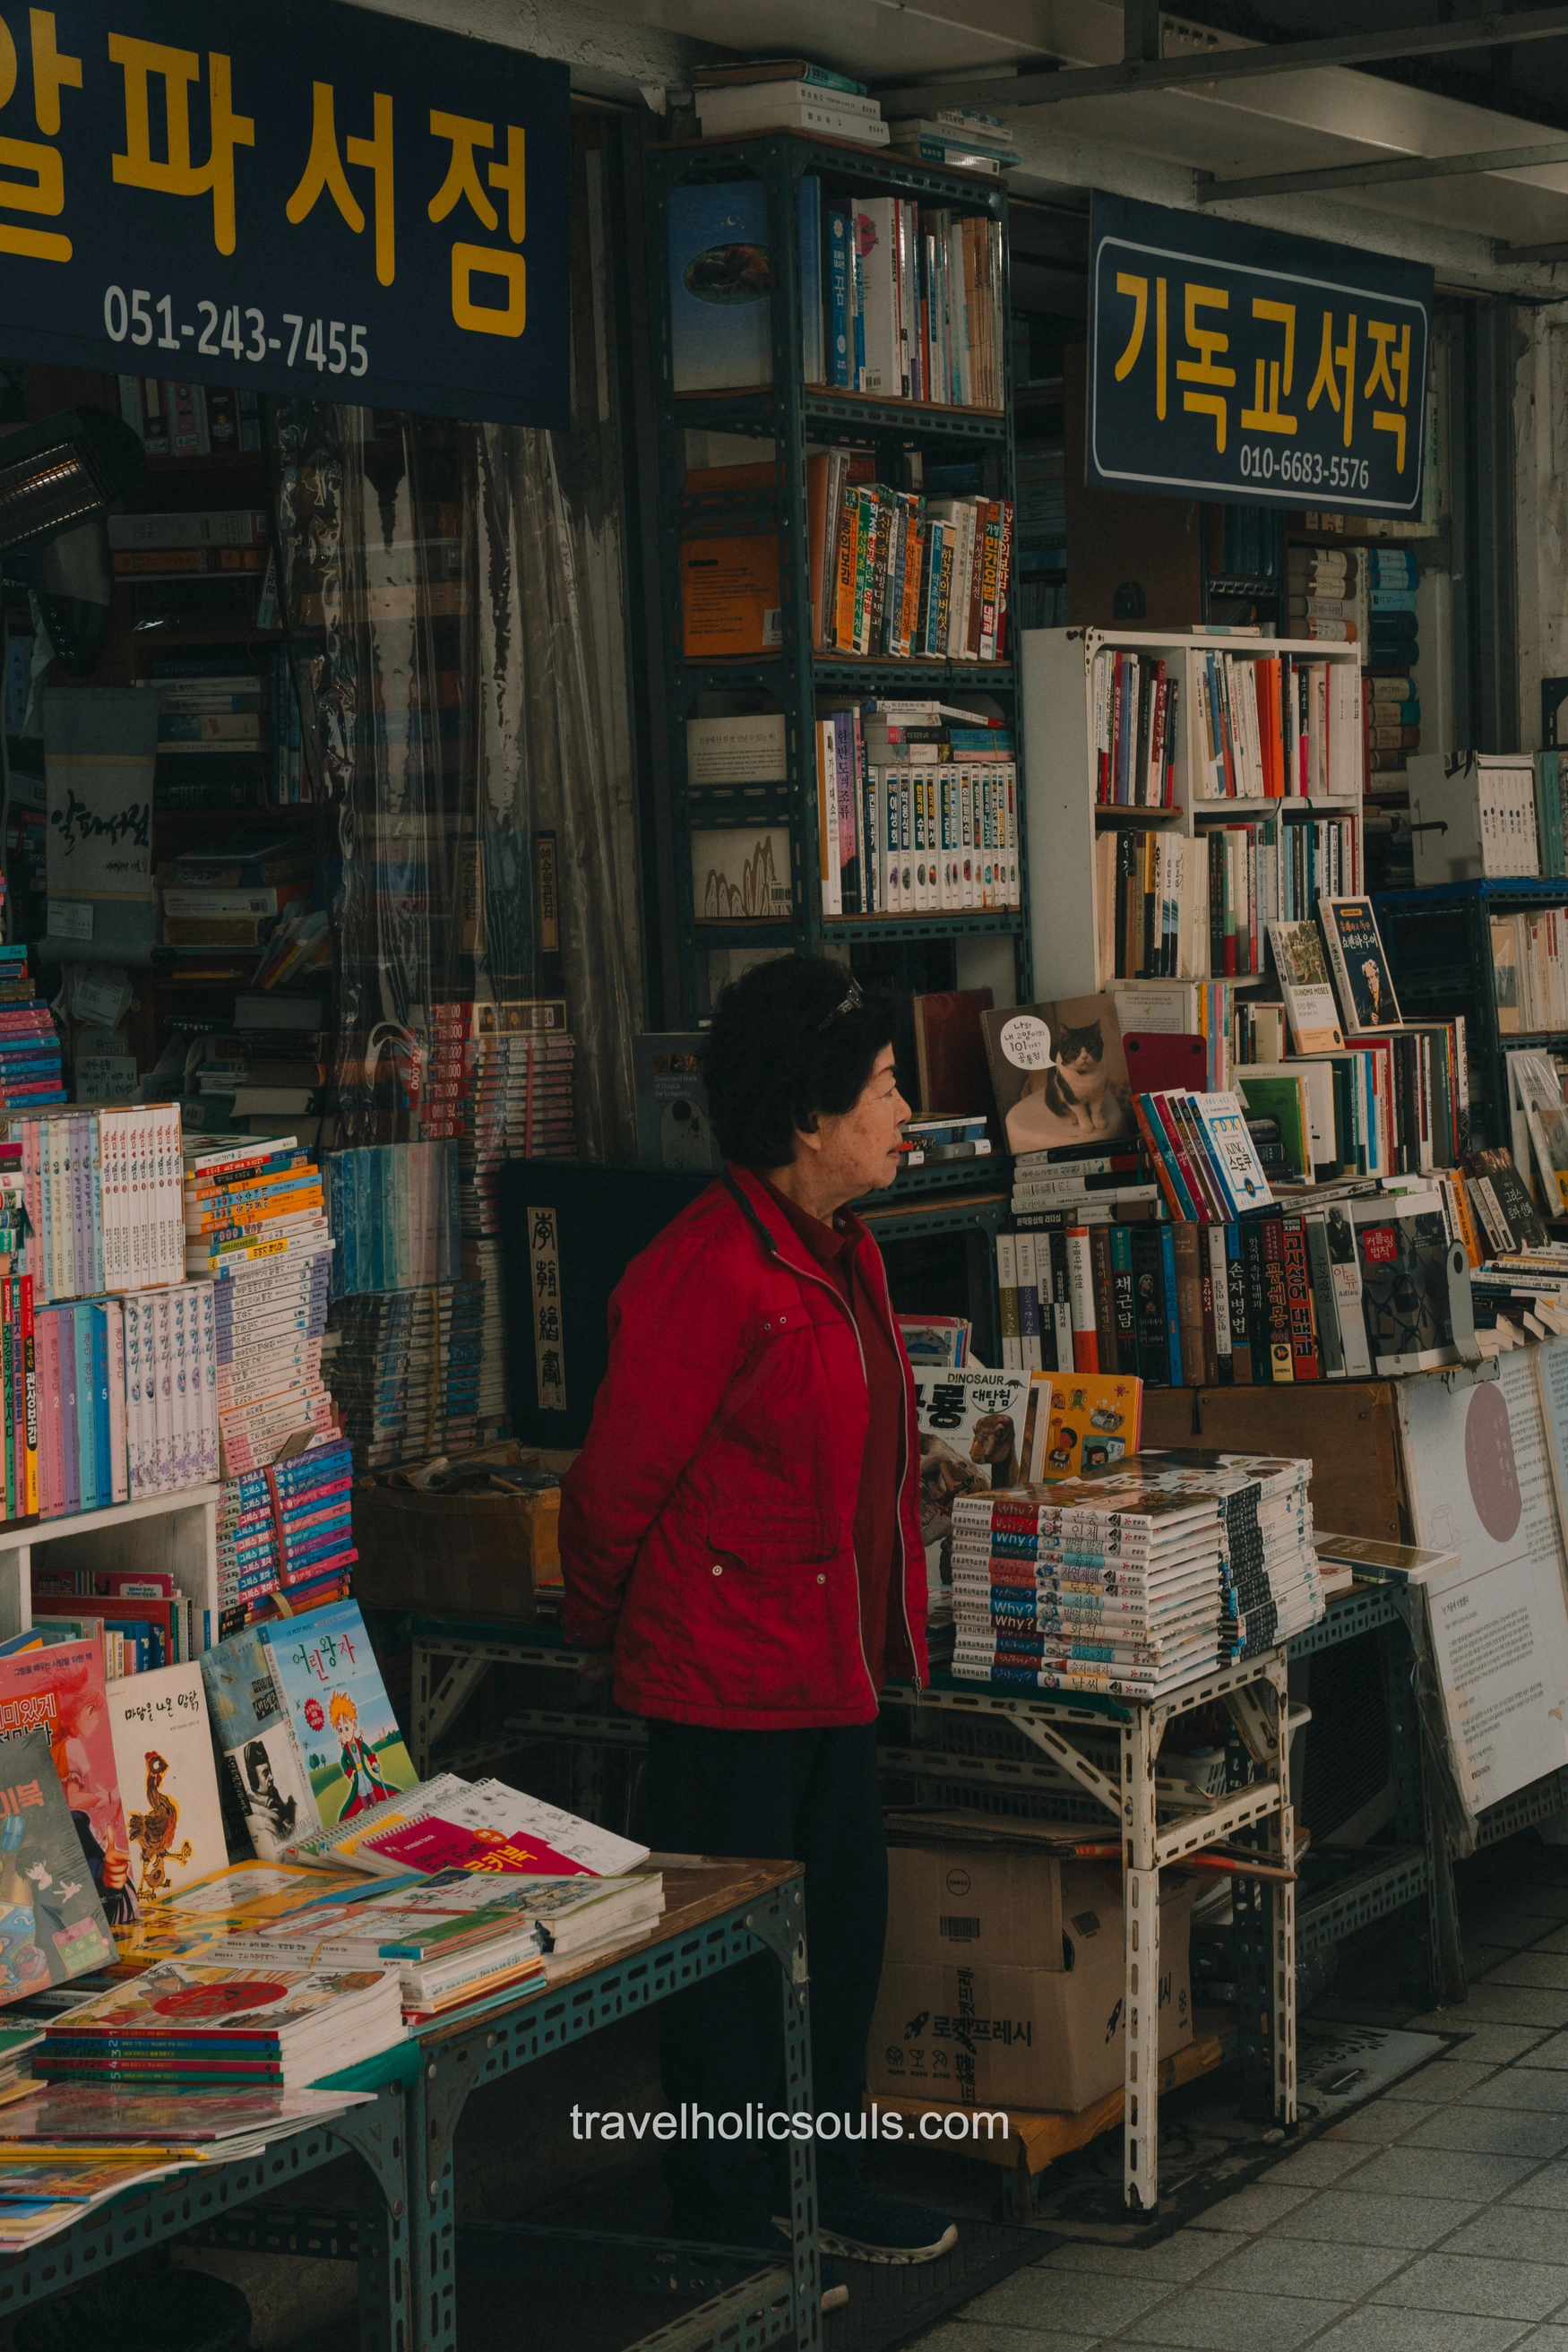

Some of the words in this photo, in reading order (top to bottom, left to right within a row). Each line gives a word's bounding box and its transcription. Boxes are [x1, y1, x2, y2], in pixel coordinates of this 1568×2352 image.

[104, 285, 368, 377] 051-243-7455
[1115, 271, 1412, 475] 기독교서적
[1240, 444, 1369, 490] 010-6683-5576
[1013, 1021, 1032, 1030] 나와
[1016, 1030, 1045, 1041] 고양이의
[1018, 1051, 1041, 1064] 공통점
[1224, 1142, 1245, 1155] KING
[1229, 1153, 1252, 1171] 스도쿠
[1504, 1188, 1523, 1204] 그리스
[1507, 1207, 1521, 1220] 로마
[1521, 1202, 1534, 1218] 신화
[1366, 1232, 1394, 1247] 커플링
[1074, 1240, 1082, 1271] 아름다운
[1248, 1236, 1260, 1262] 한국의
[1370, 1246, 1390, 1259] 법칙
[1285, 1234, 1308, 1302] 고사성어
[1333, 1266, 1357, 1290] 아듀
[1228, 1262, 1245, 1334] 손자병법
[1265, 1262, 1288, 1328] 꿈해몽
[1339, 1289, 1359, 1297] Adieu
[1115, 1275, 1133, 1328] 채근담
[1290, 1307, 1314, 1357] 대백과
[947, 1372, 1004, 1386] DINOSAUR
[69, 1394, 74, 1405] 3
[86, 1391, 92, 1401] 4
[101, 1388, 108, 1400] 5
[972, 1390, 1011, 1407] 대탐험
[25, 1372, 37, 1445] 관상보감
[54, 1398, 59, 1408] 2
[996, 1532, 1036, 1547] Why?
[1072, 1525, 1099, 1541] 인체
[1061, 1566, 1098, 1581] 자연재해
[994, 1602, 1033, 1616] Why?
[995, 1615, 1034, 1630] Why?
[293, 1633, 356, 1682] 어린왕자
[1072, 1678, 1098, 1693] 날씨
[125, 1702, 153, 1722] 마당을
[156, 1696, 174, 1718] 나온
